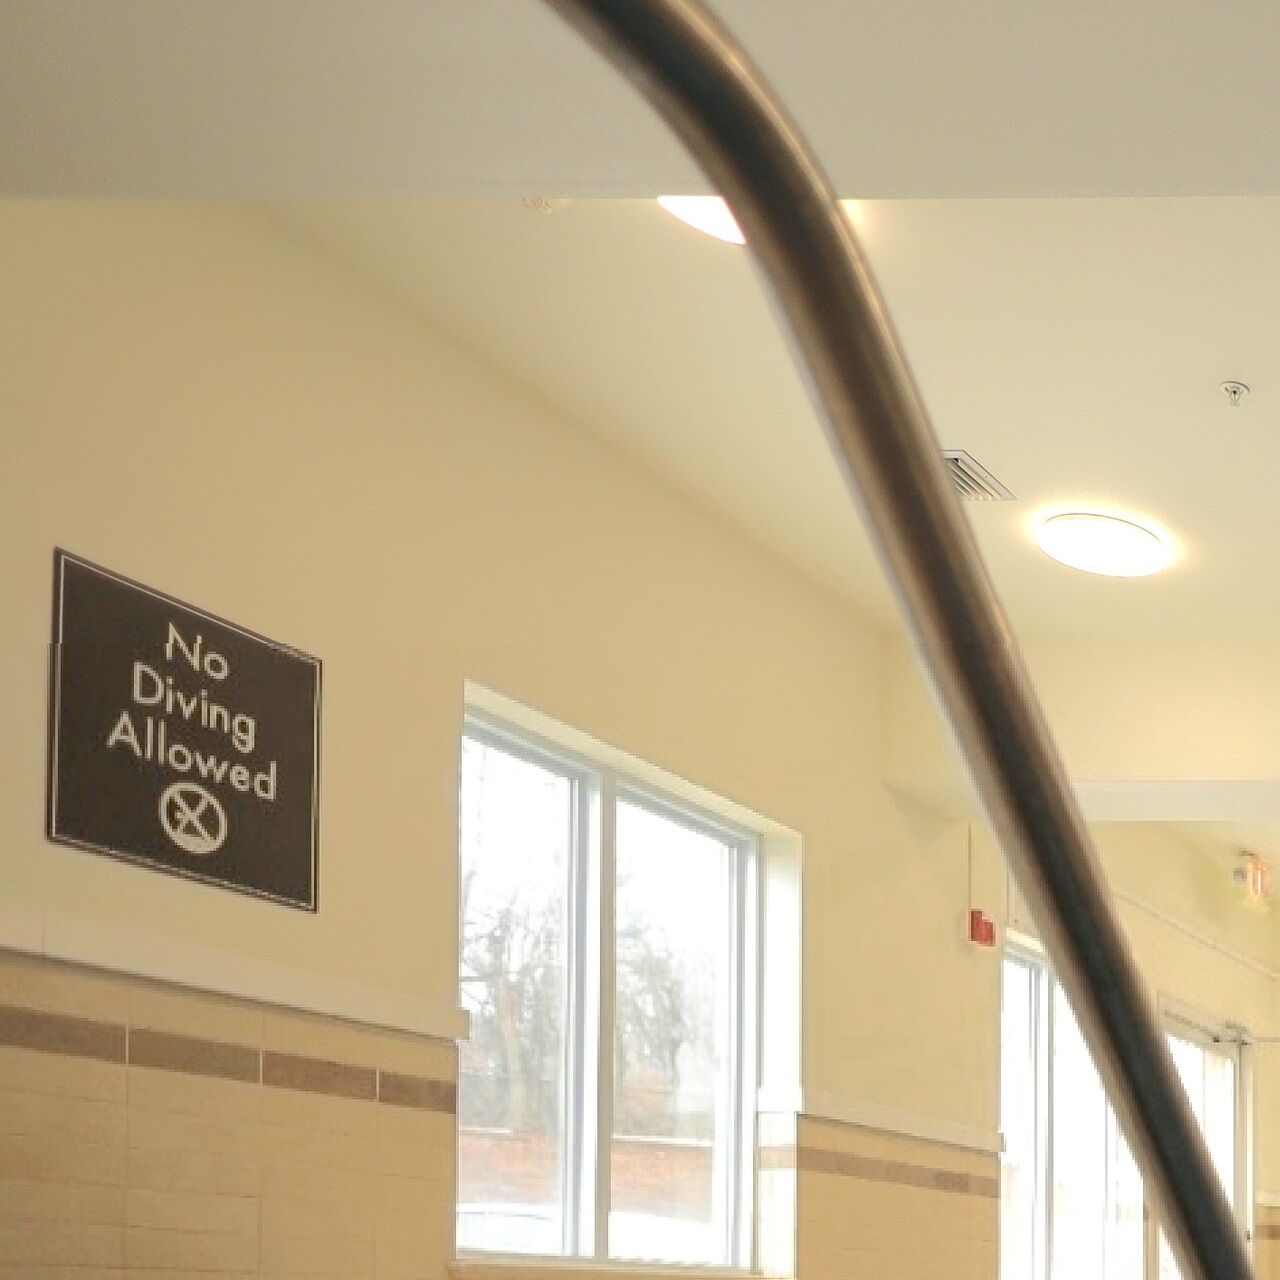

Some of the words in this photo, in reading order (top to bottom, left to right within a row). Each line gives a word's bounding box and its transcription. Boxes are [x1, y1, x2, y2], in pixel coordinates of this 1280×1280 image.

[165, 621, 229, 681] No
[133, 661, 256, 754] Diving
[106, 710, 278, 802] Allowed
